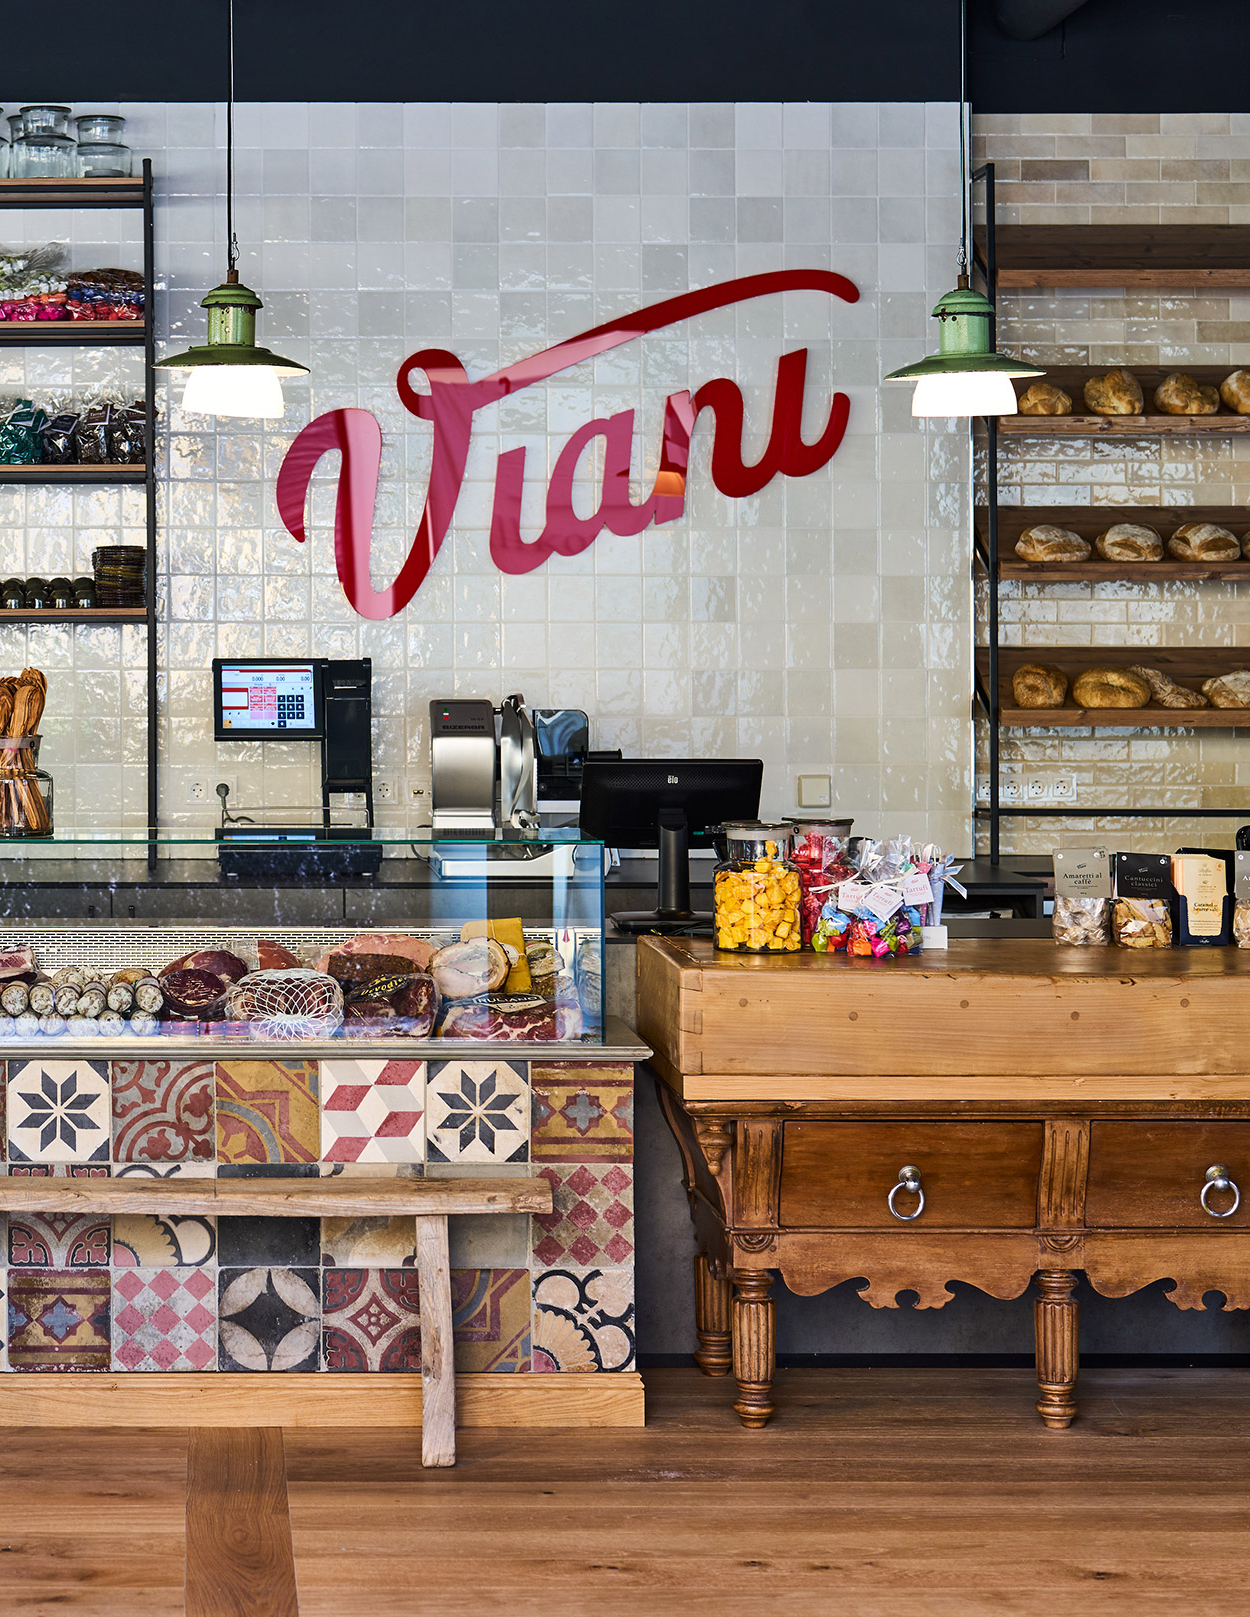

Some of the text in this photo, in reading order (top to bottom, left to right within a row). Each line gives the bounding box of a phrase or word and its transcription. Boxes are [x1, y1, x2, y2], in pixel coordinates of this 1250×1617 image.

[276, 269, 861, 621] Viani
[1124, 875, 1164, 883] Cantuccini
[872, 891, 894, 906] Tartufi
